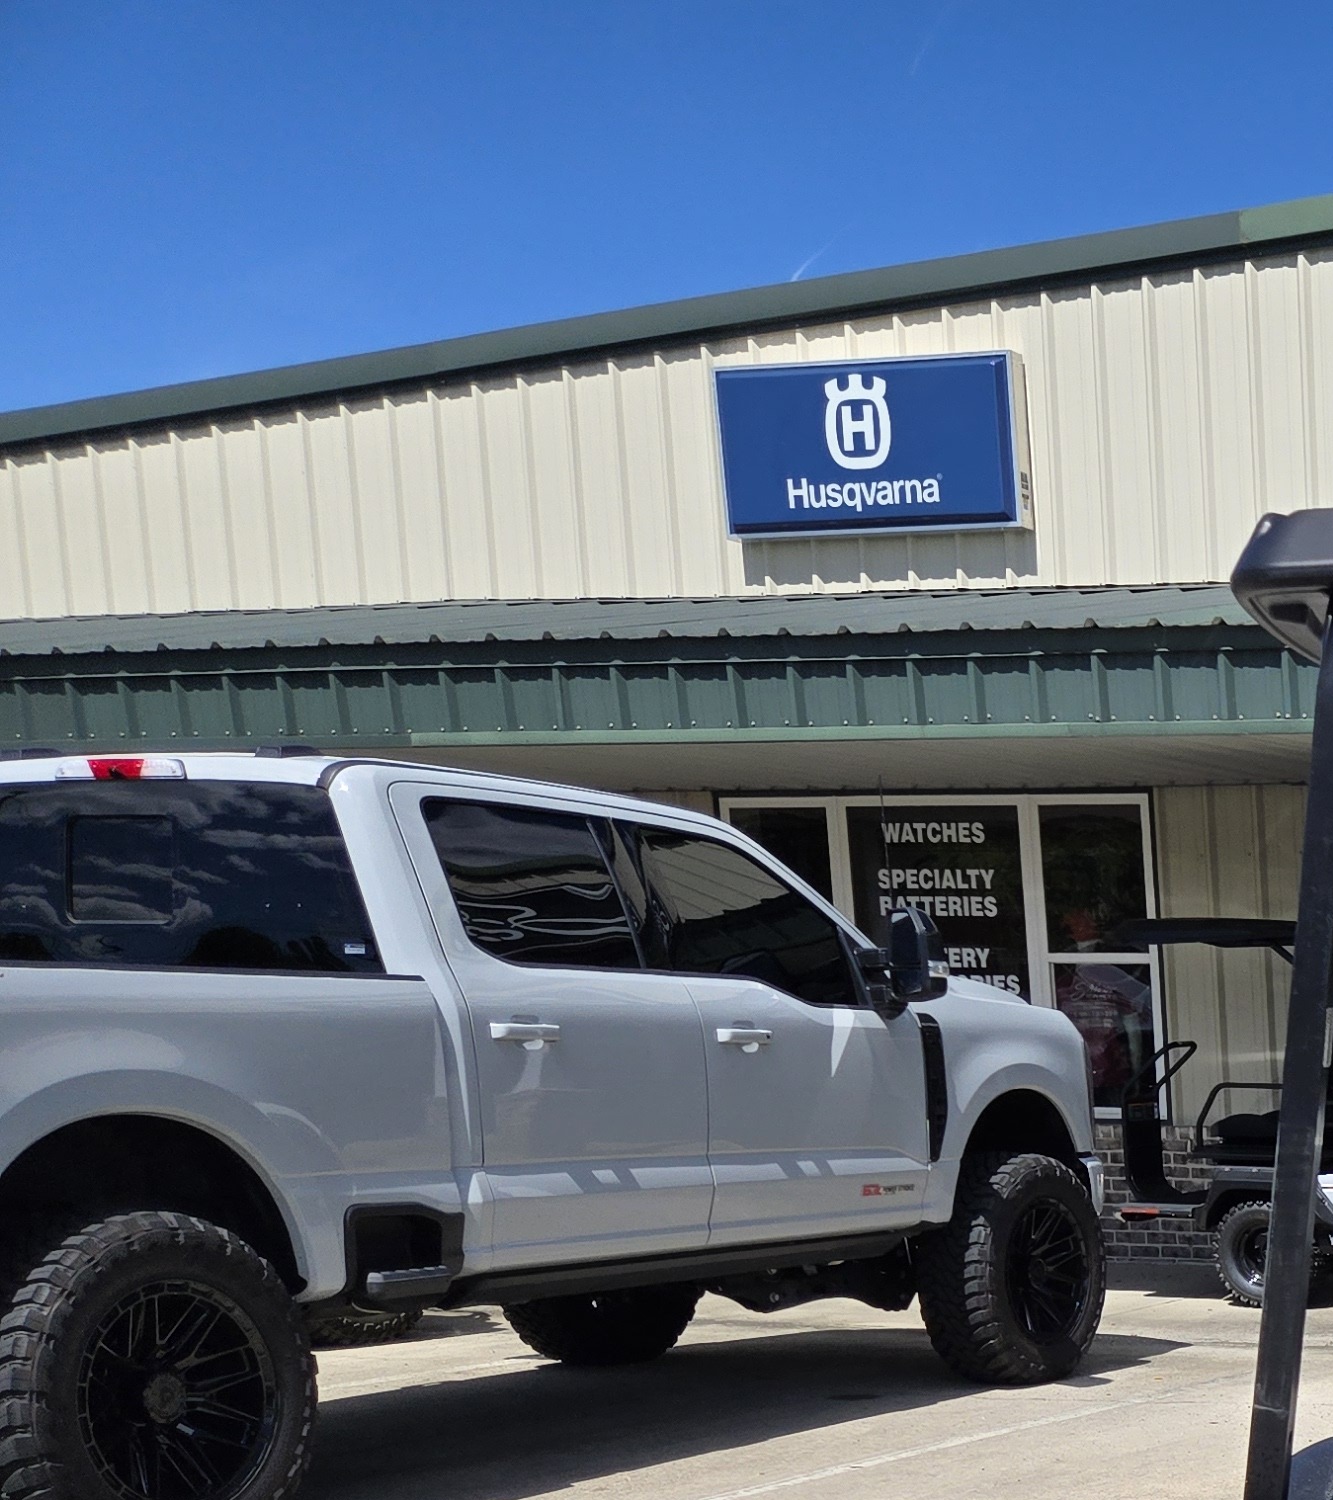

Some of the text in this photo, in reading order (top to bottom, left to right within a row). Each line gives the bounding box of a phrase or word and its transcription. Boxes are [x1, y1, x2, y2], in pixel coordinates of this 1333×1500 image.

[786, 477, 941, 513] Husqvarna
[880, 821, 986, 844] WATCHES
[877, 868, 995, 890] SPECIALTY
